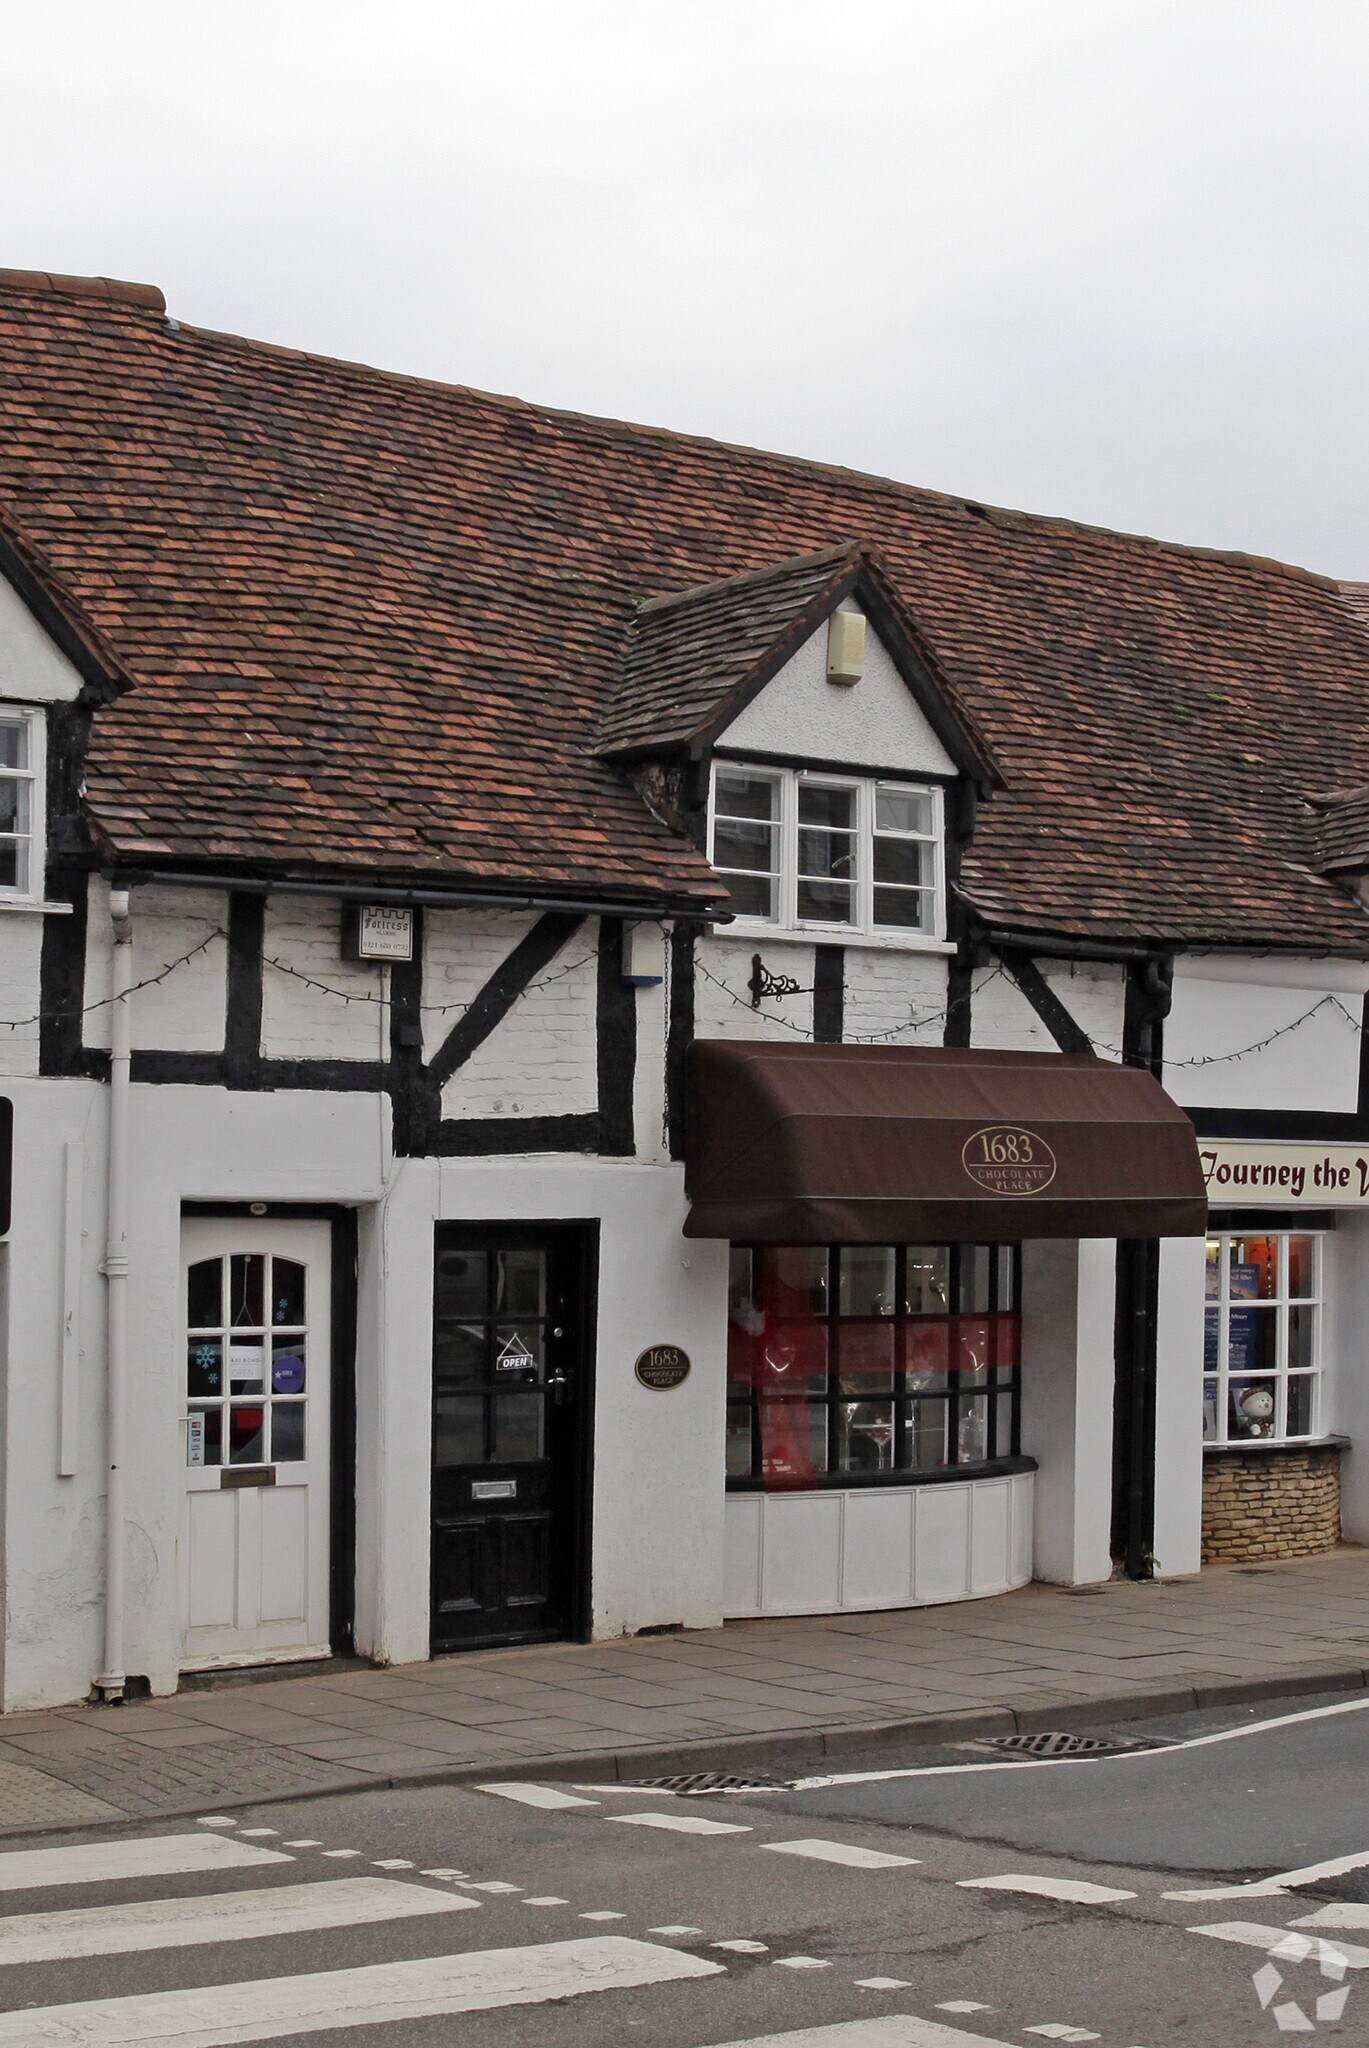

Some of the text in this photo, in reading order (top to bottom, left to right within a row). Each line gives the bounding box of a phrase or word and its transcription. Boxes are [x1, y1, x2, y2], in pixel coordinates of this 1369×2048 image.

[364, 918, 408, 930] Fortress
[980, 1134, 1033, 1162] 1683
[978, 1170, 1045, 1179] CHOCOLATE
[1313, 1157, 1350, 1190] the
[996, 1181, 1032, 1190] PLACE
[503, 1357, 528, 1368] OPEN
[650, 1350, 679, 1366] 1683
